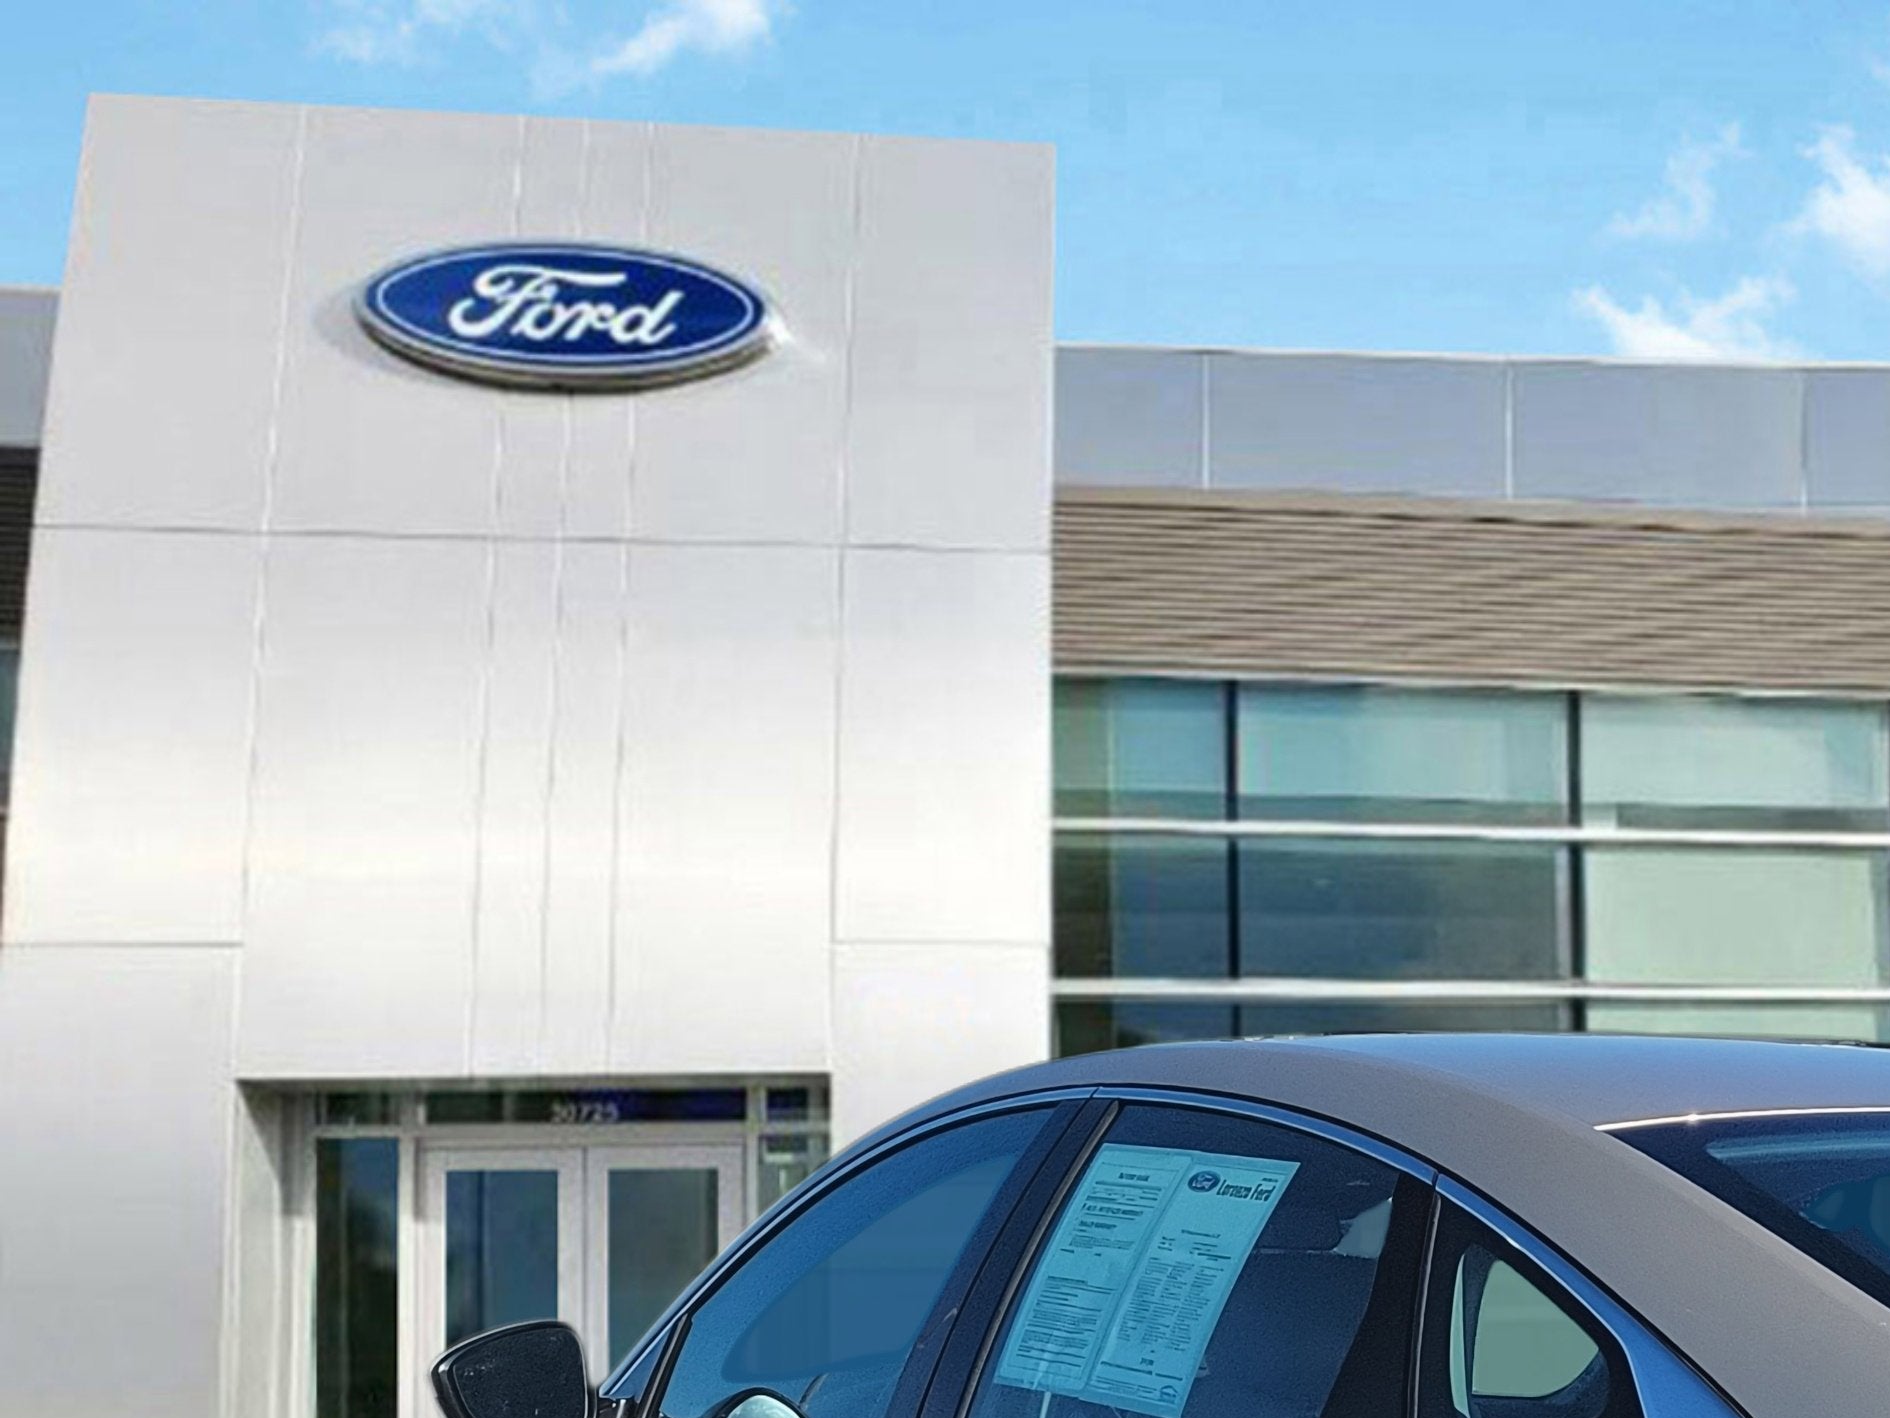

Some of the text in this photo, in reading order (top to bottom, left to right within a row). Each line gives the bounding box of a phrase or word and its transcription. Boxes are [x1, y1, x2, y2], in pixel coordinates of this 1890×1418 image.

[447, 263, 684, 345] Ford
[1216, 1179, 1276, 1202] Lorenzo Ford
